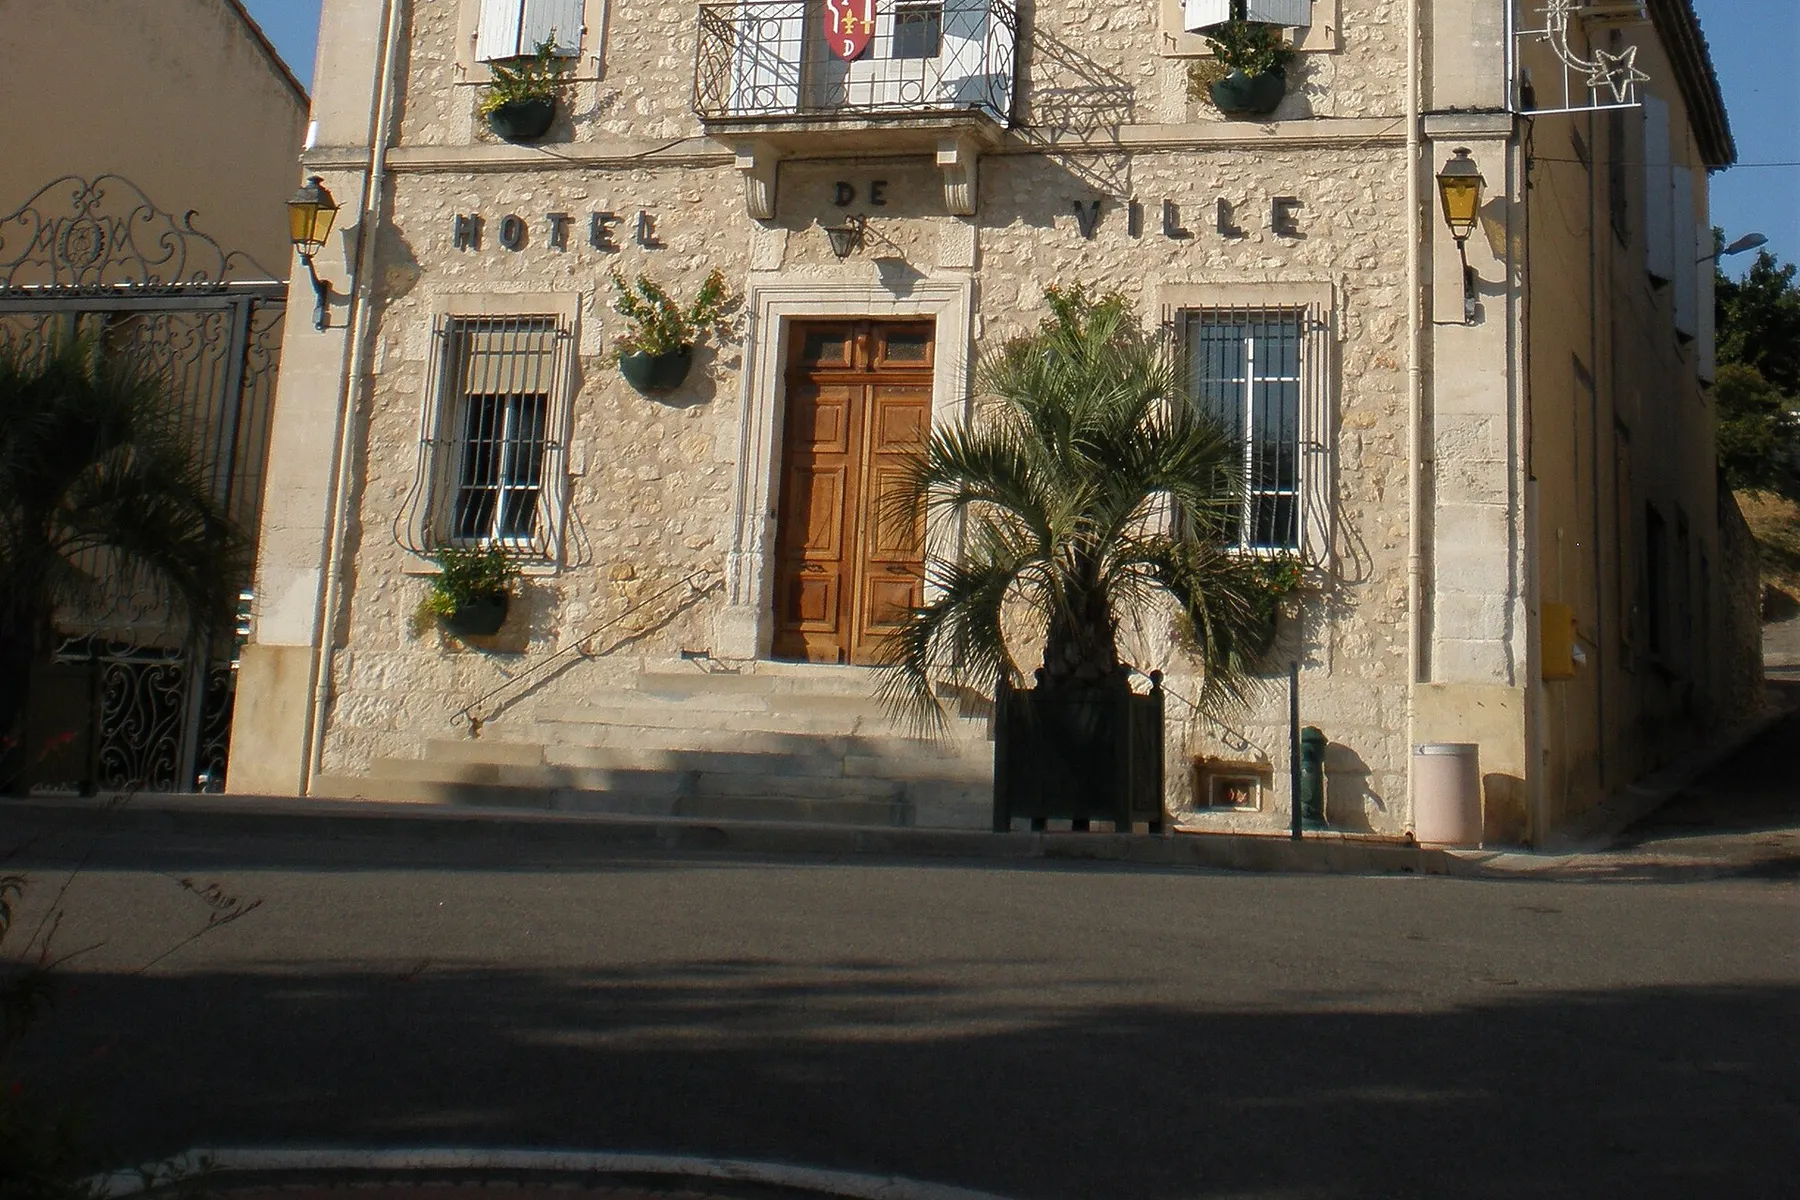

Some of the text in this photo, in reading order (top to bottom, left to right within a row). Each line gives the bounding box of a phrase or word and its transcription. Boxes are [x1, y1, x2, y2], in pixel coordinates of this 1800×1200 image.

[453, 180, 1298, 250] HOTEL DE VILLE
